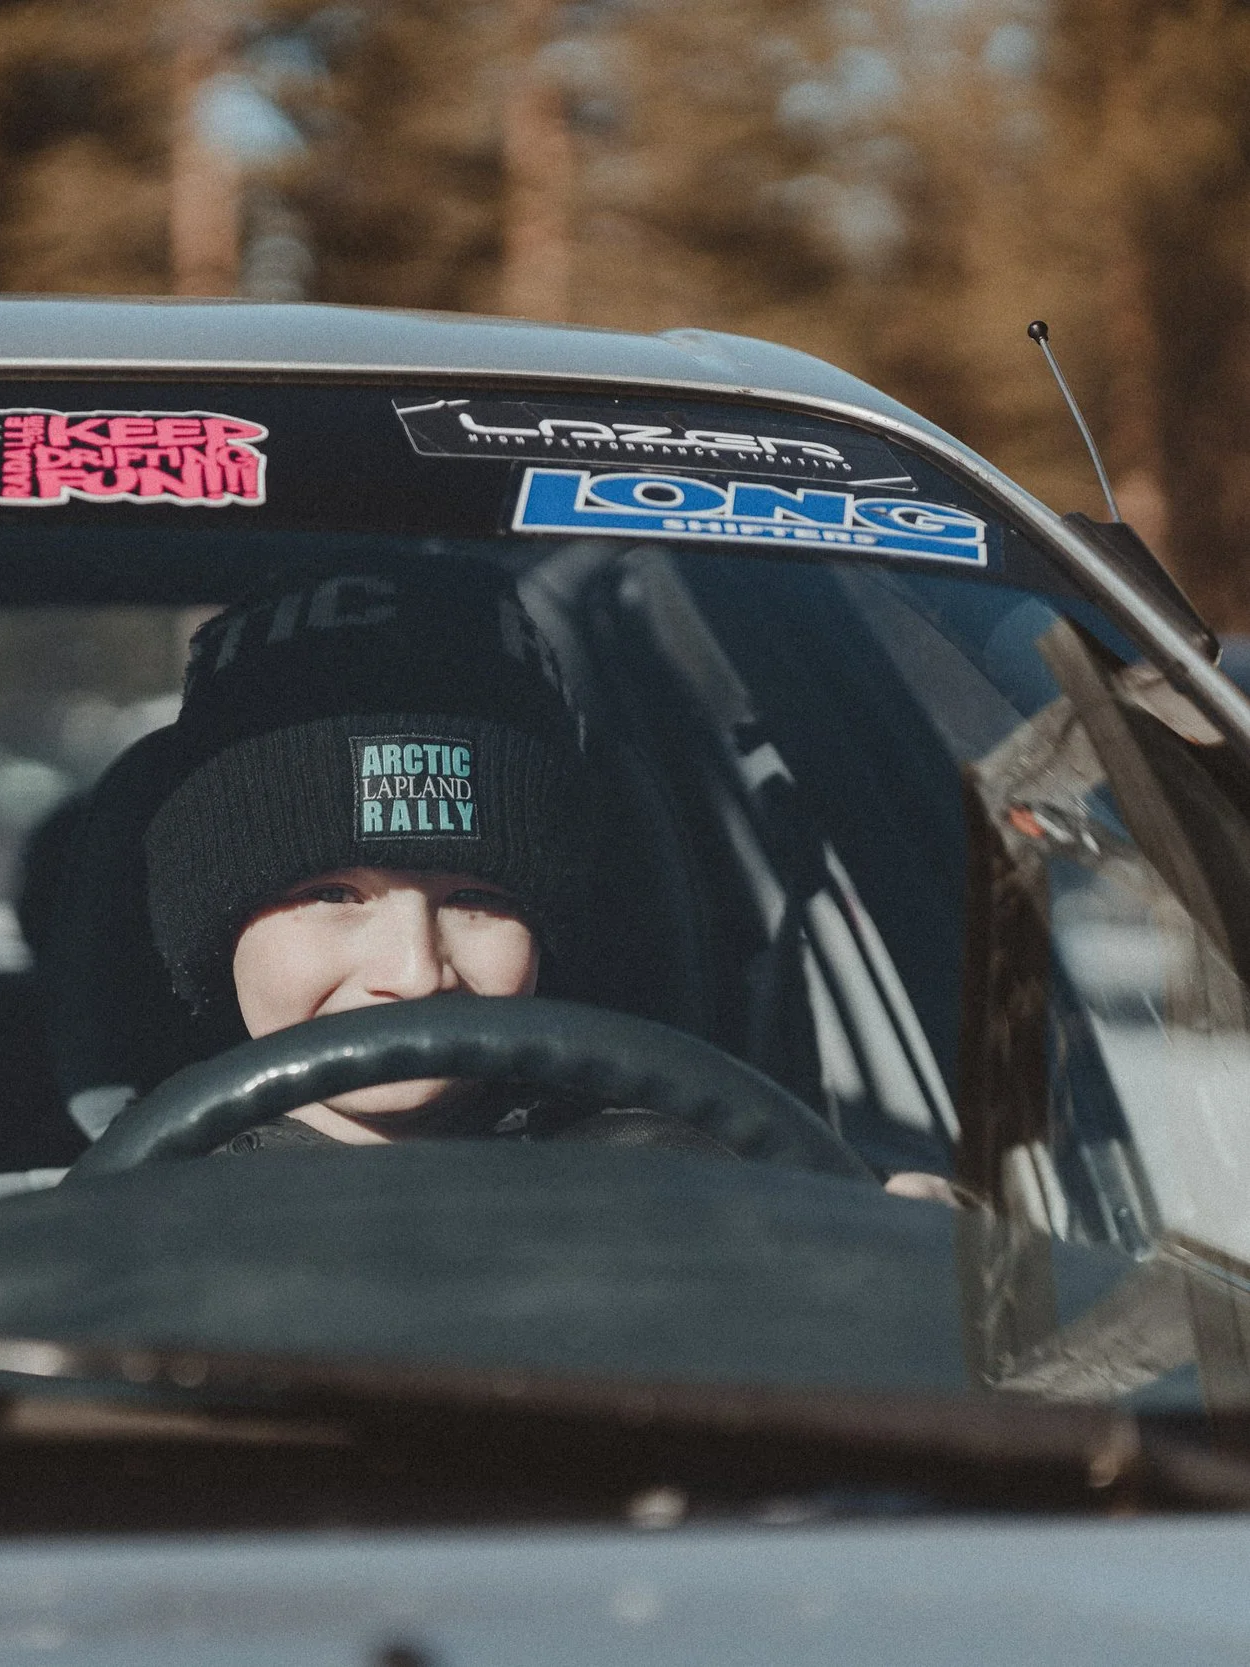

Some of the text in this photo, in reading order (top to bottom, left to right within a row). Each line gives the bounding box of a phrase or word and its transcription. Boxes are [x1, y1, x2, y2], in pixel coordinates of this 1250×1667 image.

[48, 416, 264, 448] KEEP
[468, 433, 852, 470] HIGH PERFORMANCE LIGHTING
[512, 467, 988, 567] LONG
[662, 518, 880, 545] SHIFTERS
[362, 744, 471, 777] ARCTIC
[362, 776, 471, 800] LAPLAND
[363, 800, 474, 832] RALLY
